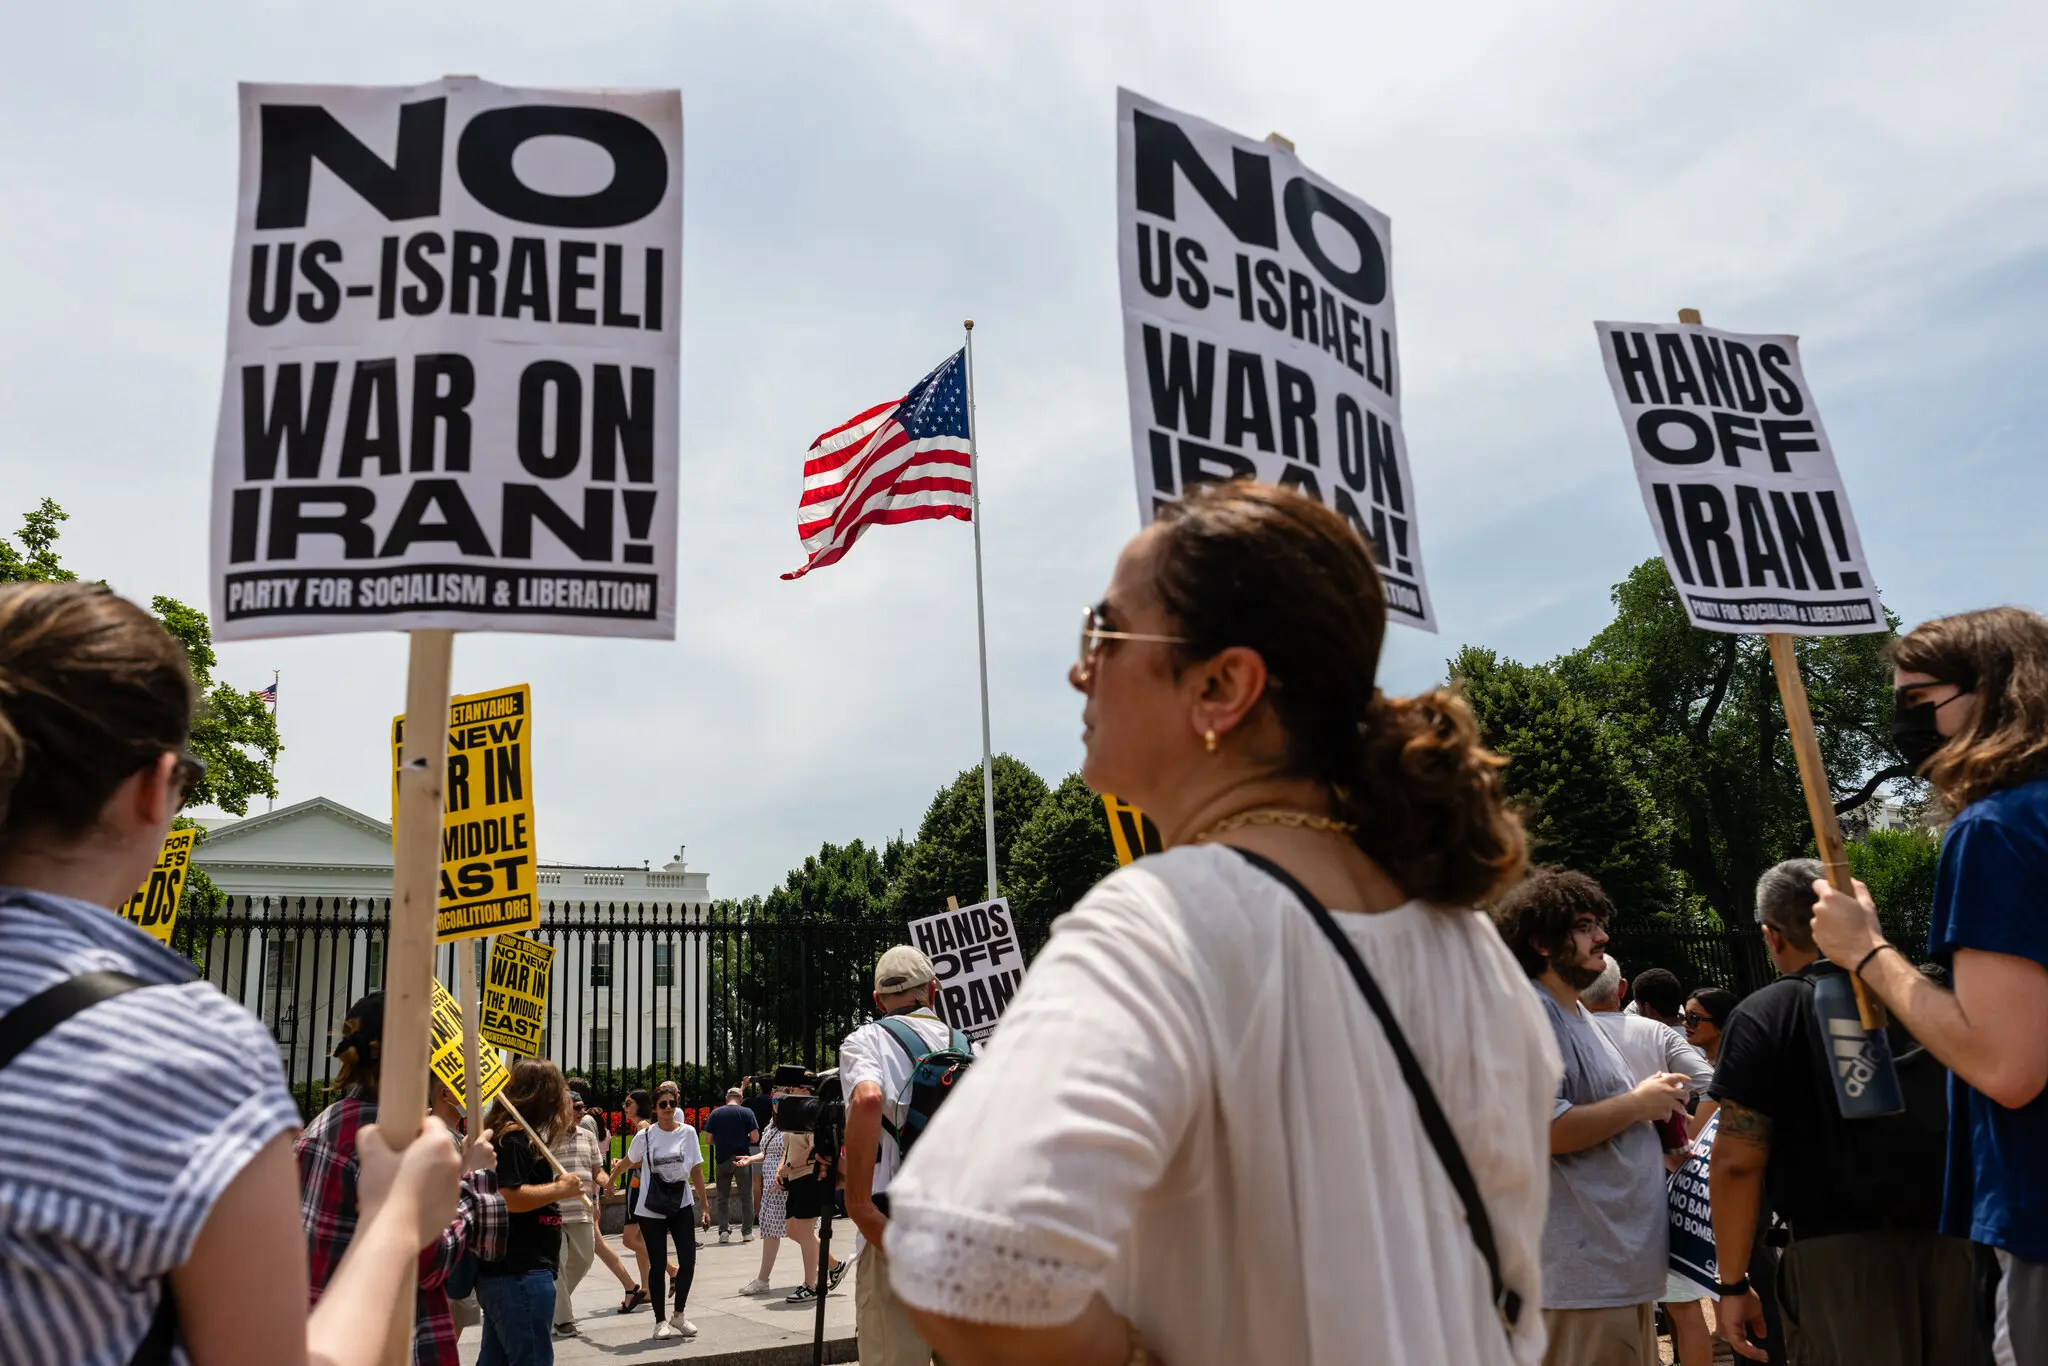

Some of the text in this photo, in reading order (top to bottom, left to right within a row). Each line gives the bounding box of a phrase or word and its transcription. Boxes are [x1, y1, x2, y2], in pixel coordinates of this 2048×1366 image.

[256, 97, 669, 230] NO
[1133, 108, 1386, 305] NO
[247, 230, 663, 331] US-ISRAELI
[1136, 222, 1393, 398] US-ISRAELI
[1610, 330, 1804, 416] HANDS
[241, 353, 655, 484] WAR ON
[1142, 322, 1405, 514] WAR ON
[1636, 408, 1820, 473] OFF
[229, 479, 657, 565] IRAN!
[1652, 483, 1864, 591] IRAN!
[229, 573, 651, 613] PARTY FOR SOCIALISM & LIBERATION
[1693, 599, 1872, 622] PARTY FOR SOCIALISM & LIBERATION
[450, 696, 518, 725] ETANYAHU:
[448, 718, 524, 751] NEW
[484, 743, 523, 806] IN
[164, 835, 190, 851] FOR
[442, 813, 528, 863] MIDDLE
[439, 855, 528, 901] AST
[915, 903, 1009, 957] HANDS
[490, 957, 546, 1000] WAR IN
[494, 945, 549, 972] NO NEW
[932, 937, 1015, 980] OFF
[484, 1009, 540, 1039] EAST
[486, 989, 543, 1022] THE MIDDLE
[434, 1051, 464, 1079] THE
[451, 1048, 497, 1098] EST
[1670, 1190, 1687, 1209] NO
[1675, 1174, 1691, 1190] NO
[1670, 1210, 1683, 1227] NO
